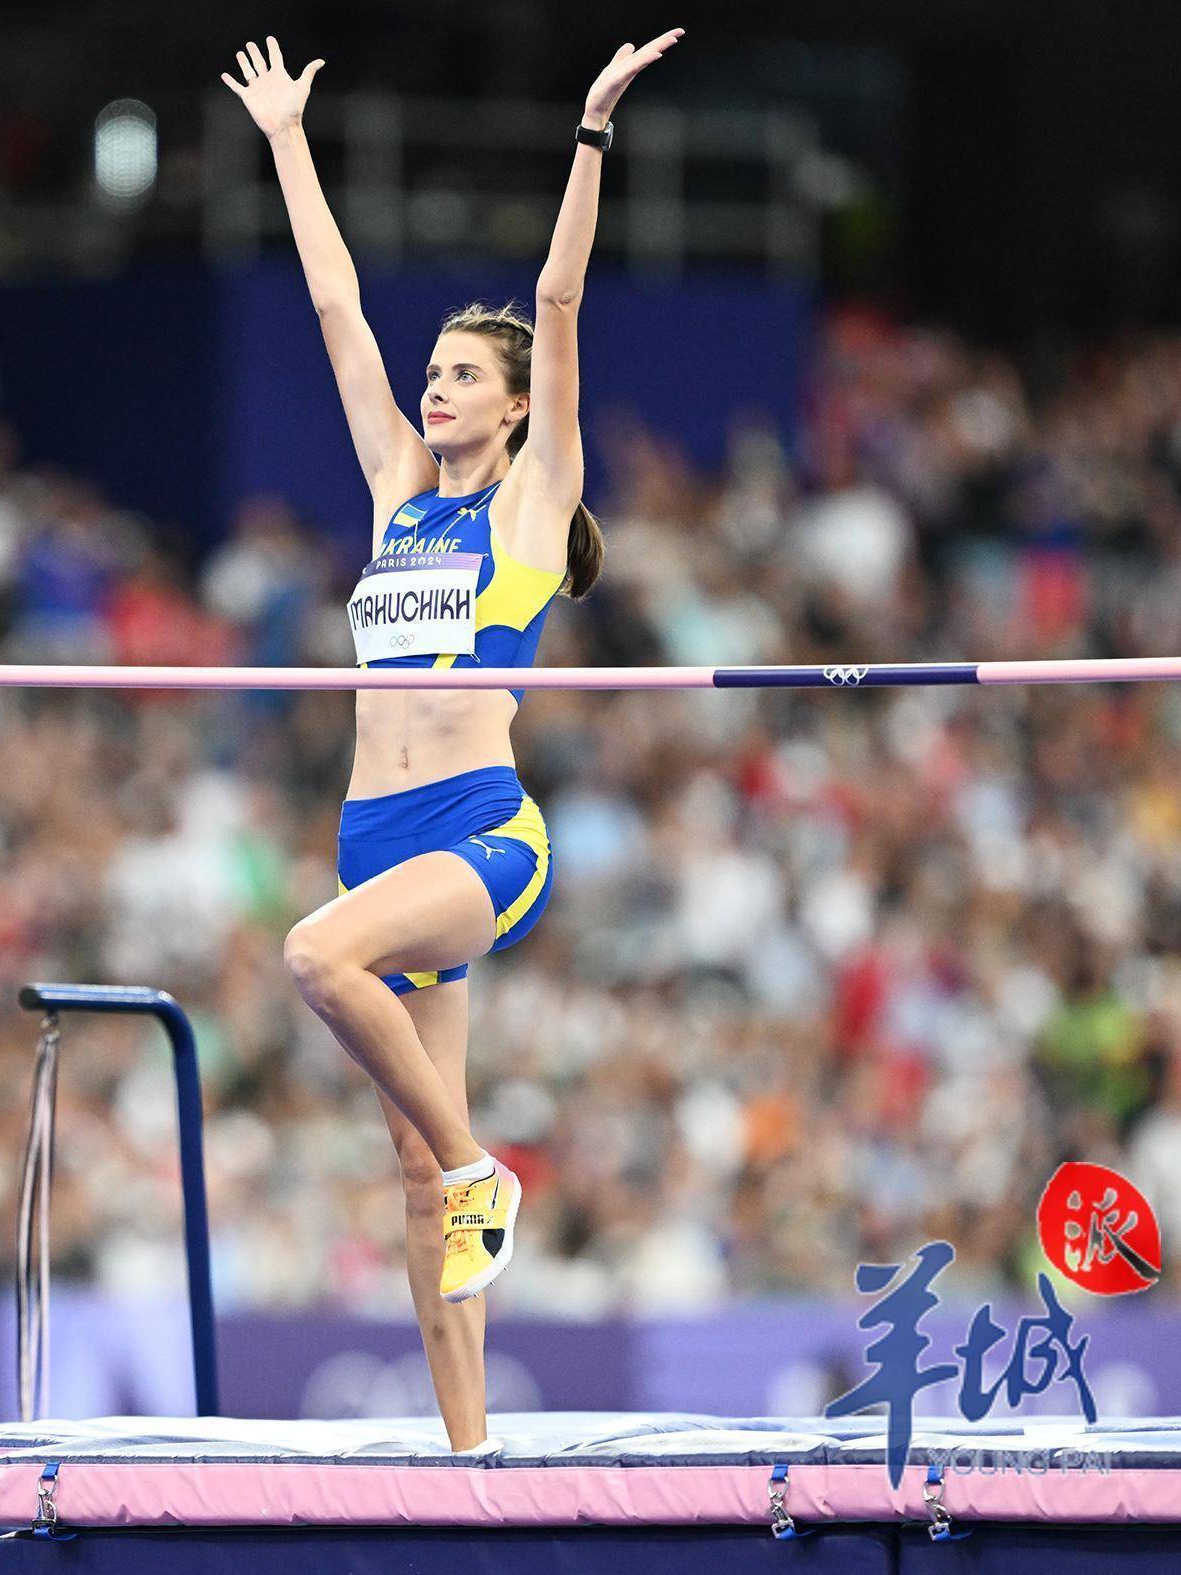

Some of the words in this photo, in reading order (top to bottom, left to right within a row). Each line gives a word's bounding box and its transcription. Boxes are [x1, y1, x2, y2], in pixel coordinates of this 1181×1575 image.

[376, 557, 407, 570] PARIS
[410, 556, 443, 567] 2024
[351, 589, 470, 630] MAHUCHIKH
[451, 1214, 485, 1226] PUMA
